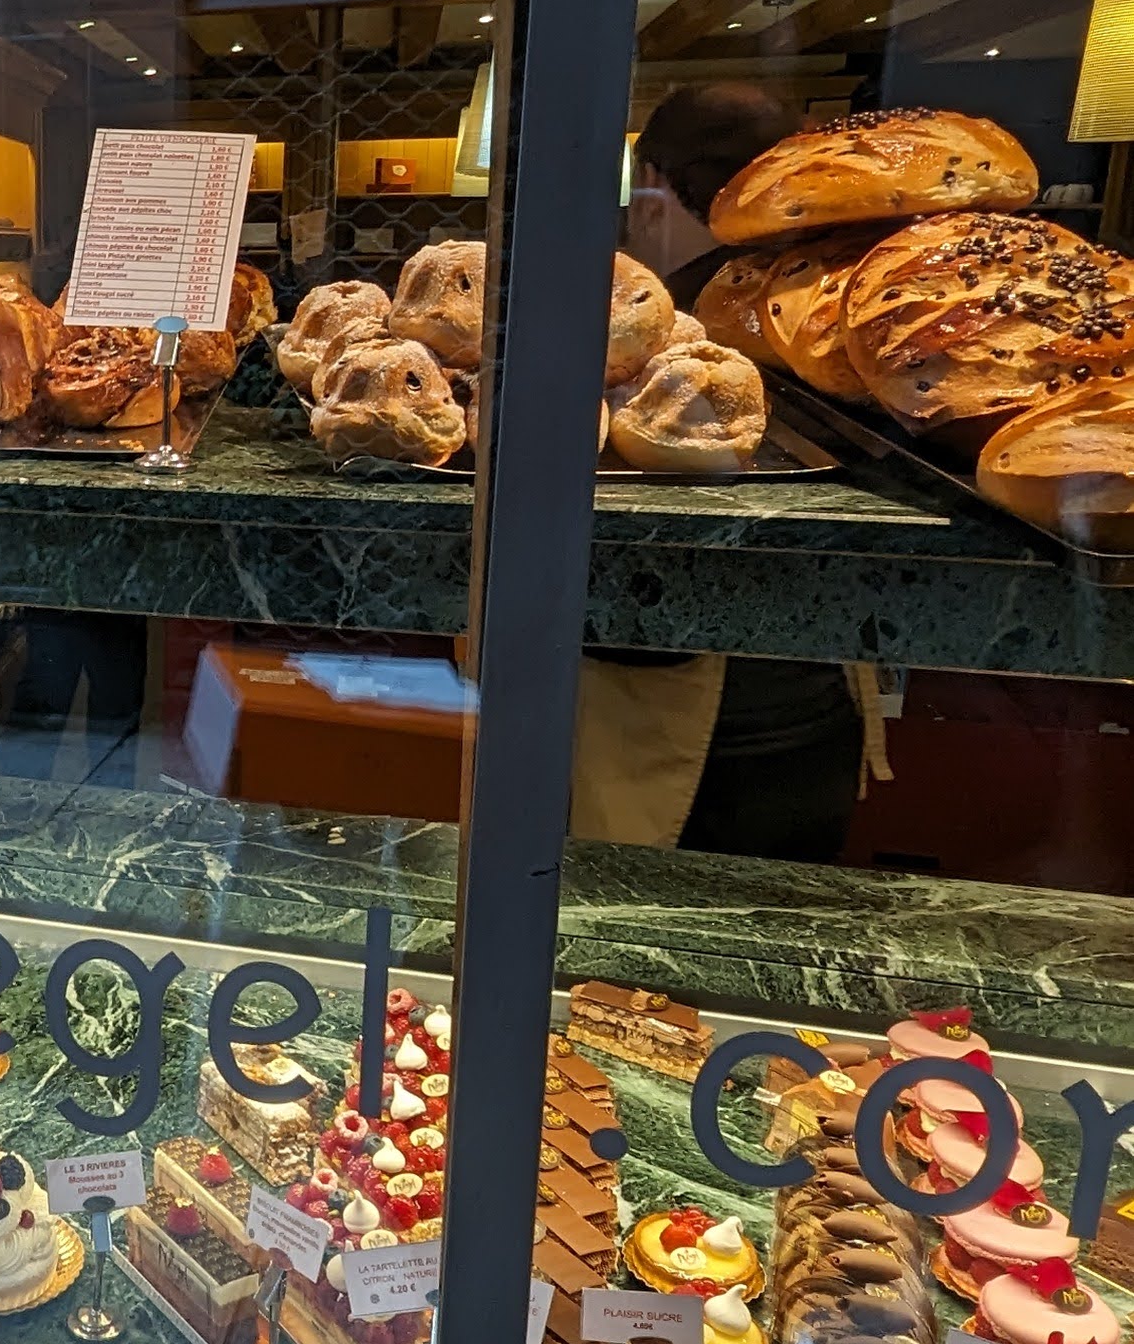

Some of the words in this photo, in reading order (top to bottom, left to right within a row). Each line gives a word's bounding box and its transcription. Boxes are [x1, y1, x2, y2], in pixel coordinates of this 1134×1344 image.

[64, 1165, 75, 1174] LE
[80, 1164, 85, 1172] 3
[87, 1159, 126, 1171] RIVIERES
[358, 1266, 370, 1274] LA
[370, 1258, 425, 1272] TARTELETTE
[410, 1283, 417, 1291] €
[603, 1307, 644, 1320] PLAISIR
[647, 1311, 683, 1323] SUCRE
